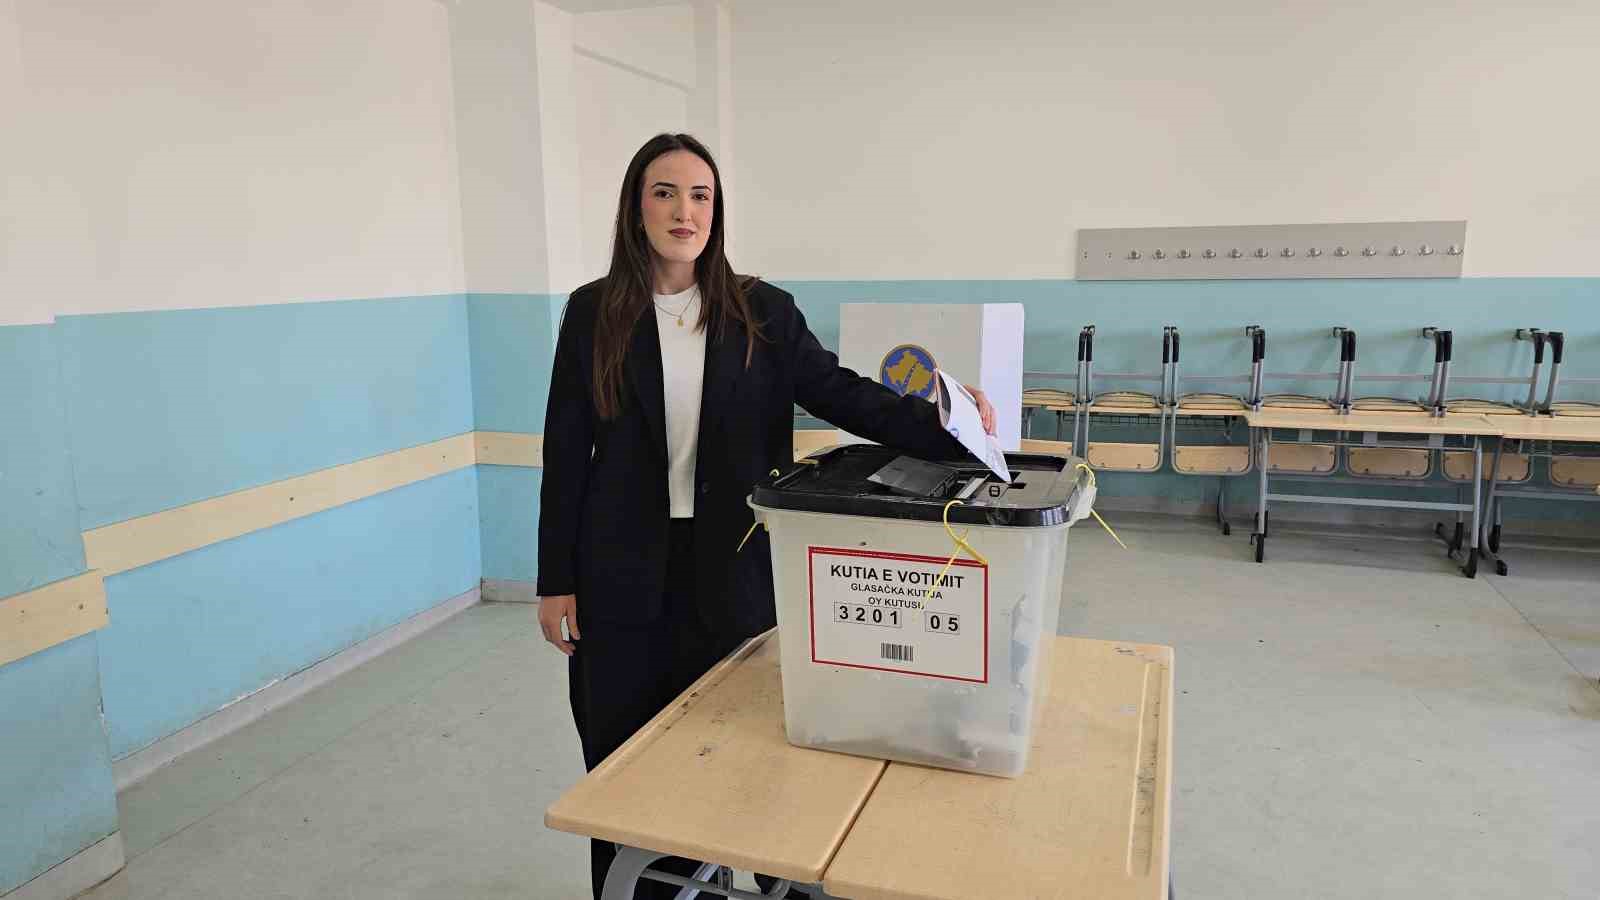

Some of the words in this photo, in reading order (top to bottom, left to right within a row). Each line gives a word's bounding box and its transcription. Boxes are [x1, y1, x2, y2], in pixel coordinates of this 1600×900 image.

[831, 564, 878, 580] KUTIA
[882, 569, 893, 582] E
[897, 570, 965, 588] VOTIMIT
[851, 583, 905, 596] GLASAČKA
[868, 597, 882, 606] OY
[930, 614, 959, 632] 05
